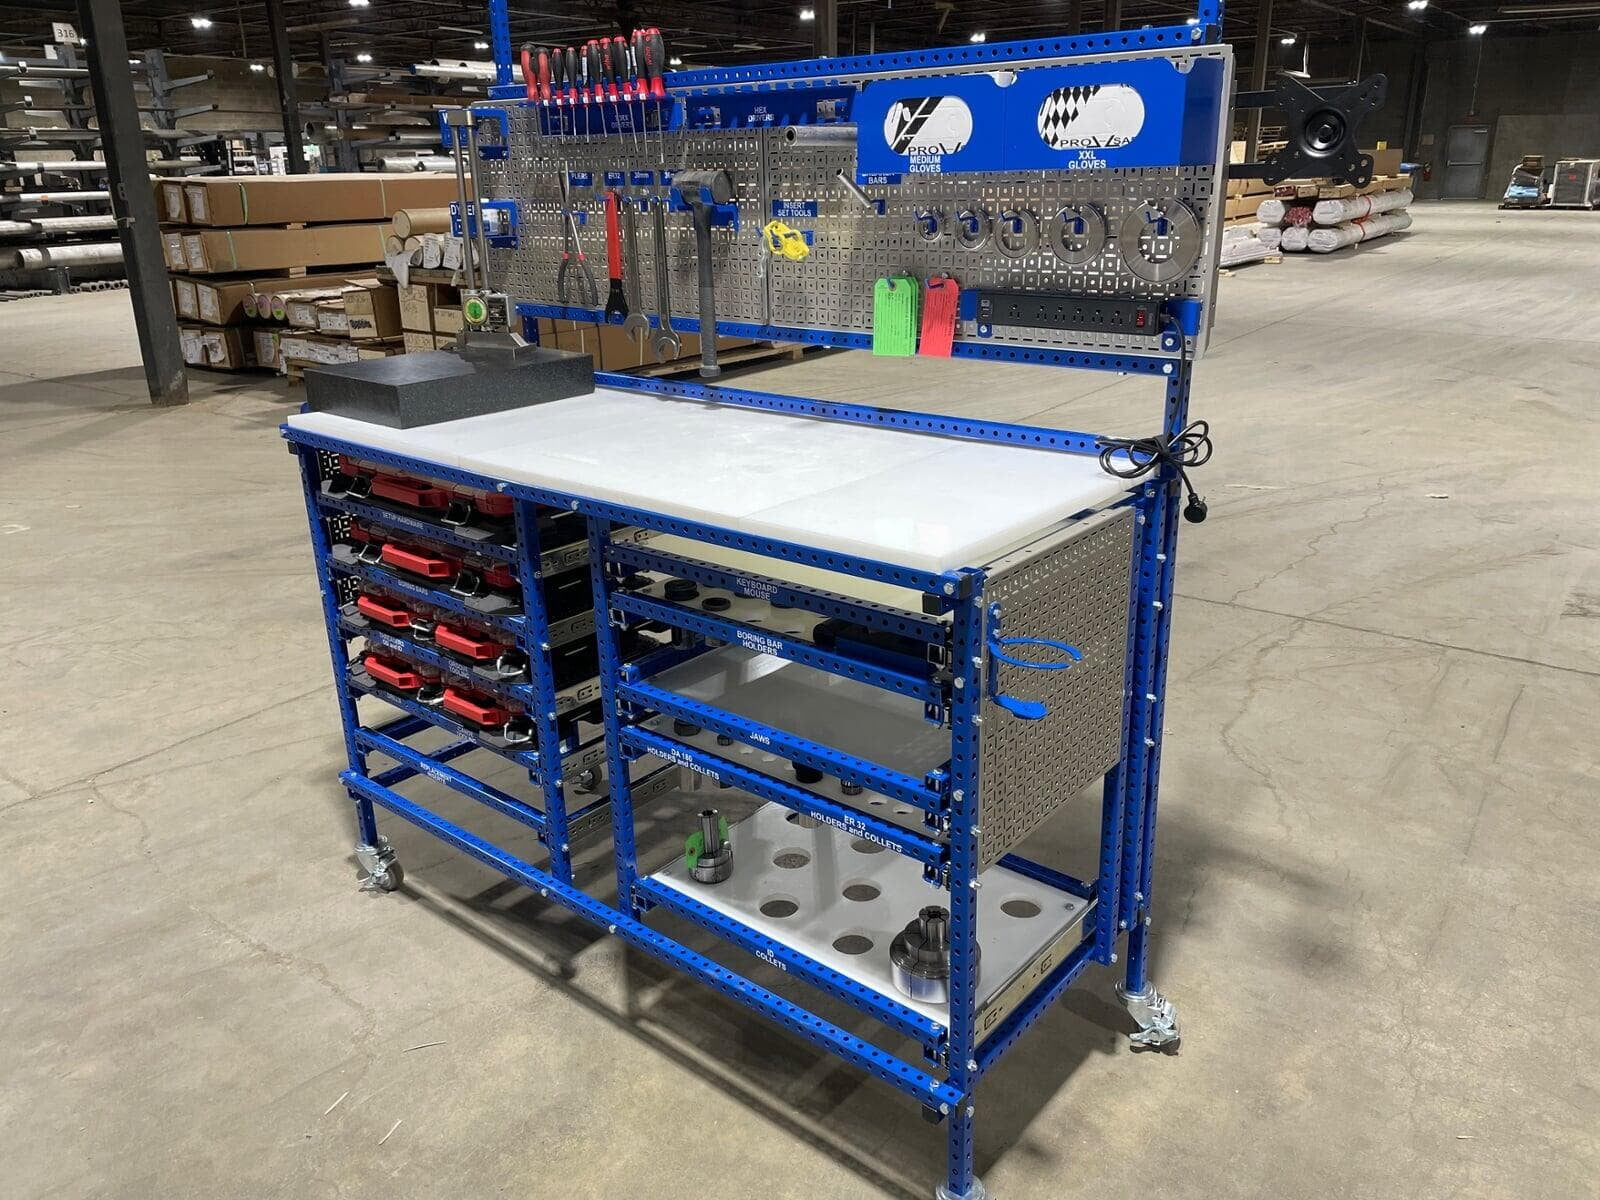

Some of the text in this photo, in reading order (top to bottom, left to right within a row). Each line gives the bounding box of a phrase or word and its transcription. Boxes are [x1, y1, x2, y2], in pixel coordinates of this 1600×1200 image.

[57, 29, 74, 38] 316
[754, 106, 767, 114] HEX
[909, 155, 941, 164] MEDIUM
[1078, 150, 1097, 160] XXL
[909, 164, 941, 173] GLOVES
[1068, 159, 1107, 170] GLOVES
[868, 176, 888, 185] BARS
[782, 202, 805, 210] INSERT
[777, 209, 812, 217] SET TOOLS
[736, 577, 778, 594] KEYBOARD
[743, 587, 771, 600] MOUSE
[736, 630, 783, 650] BORING BAR
[742, 639, 778, 656] HOLDERS
[749, 731, 770, 745] JAWS
[671, 748, 682, 758] DA
[647, 746, 720, 780] HOLDERS and COLLETS
[843, 814, 867, 831] ER 32
[810, 810, 903, 853] HOLDERS and COLLETS
[755, 950, 787, 971] COLLETS
